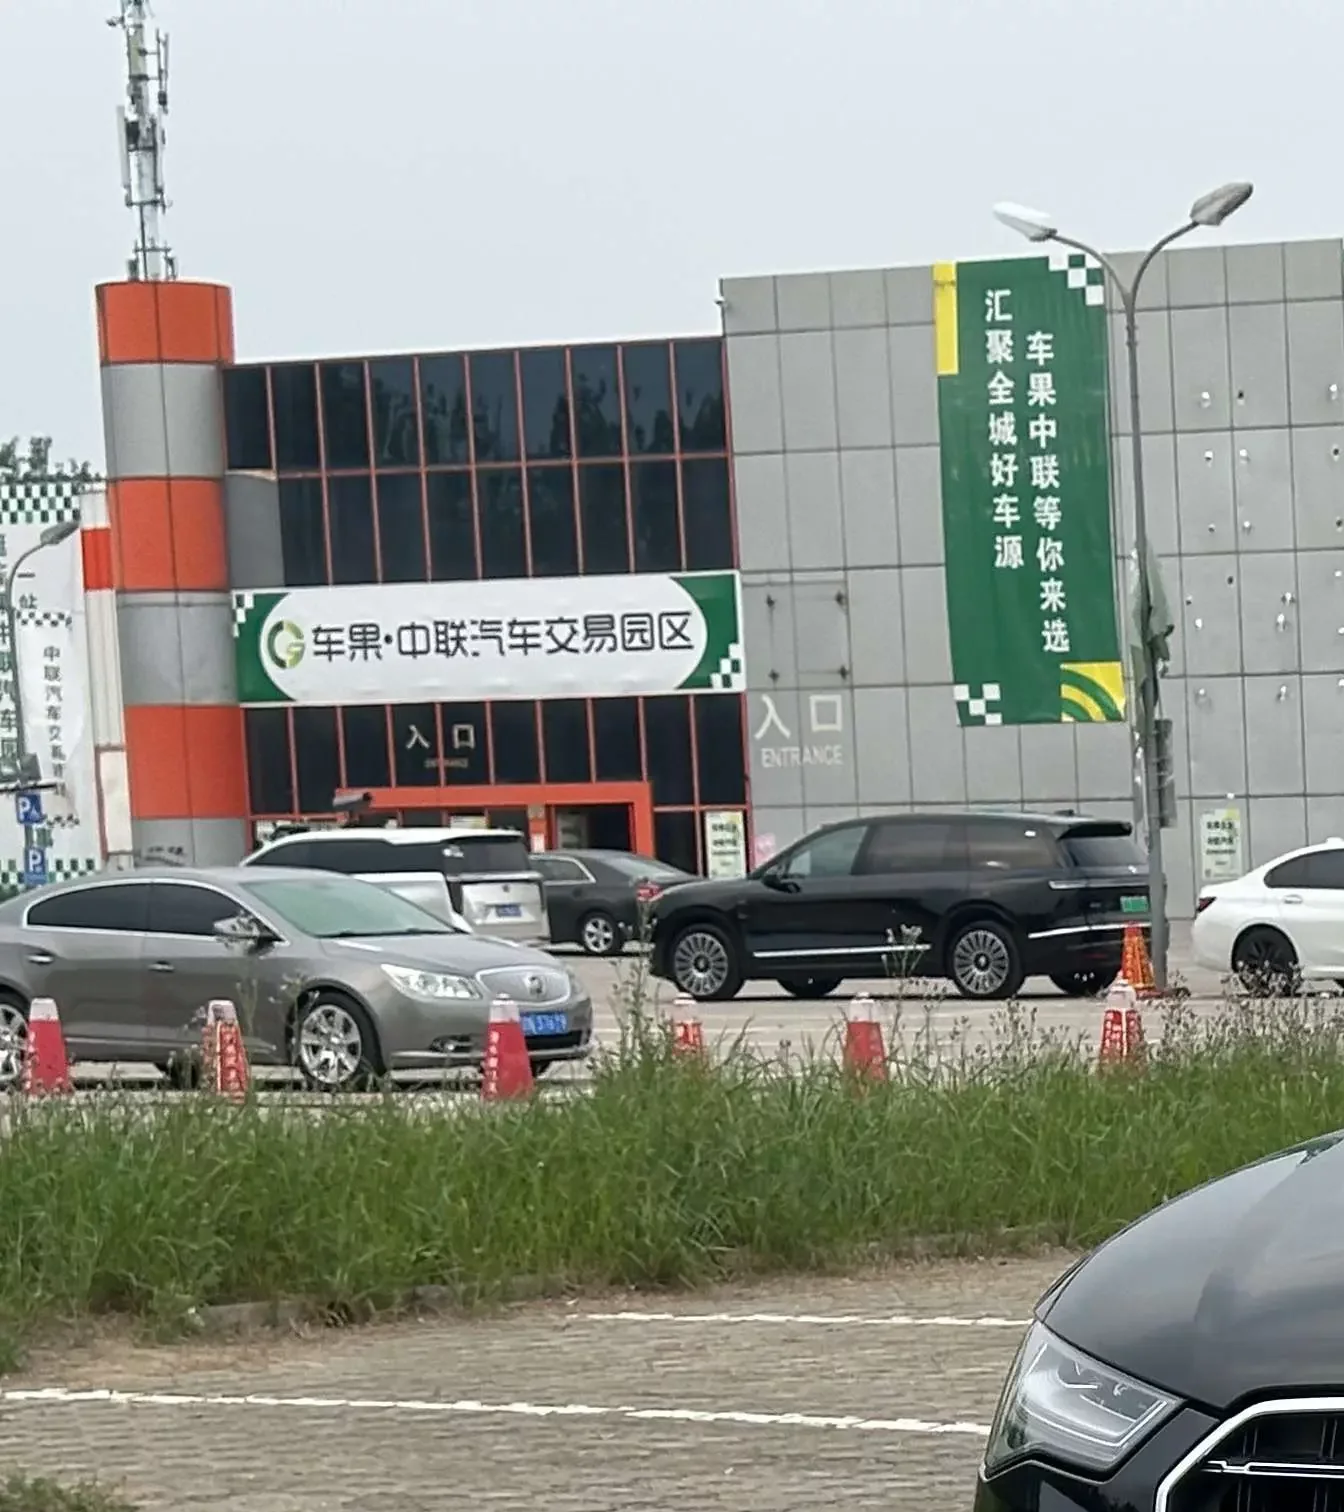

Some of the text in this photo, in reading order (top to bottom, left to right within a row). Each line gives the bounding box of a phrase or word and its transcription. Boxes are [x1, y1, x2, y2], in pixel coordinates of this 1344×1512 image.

[985, 289, 1024, 569] 汇聚全城好车源
[1026, 331, 1070, 653] 车果中联等你来选
[311, 611, 694, 663] 车果·中联汽车交易园区
[405, 724, 475, 749] 入口
[754, 693, 842, 740] 入口
[761, 744, 843, 768] ENTRANCE
